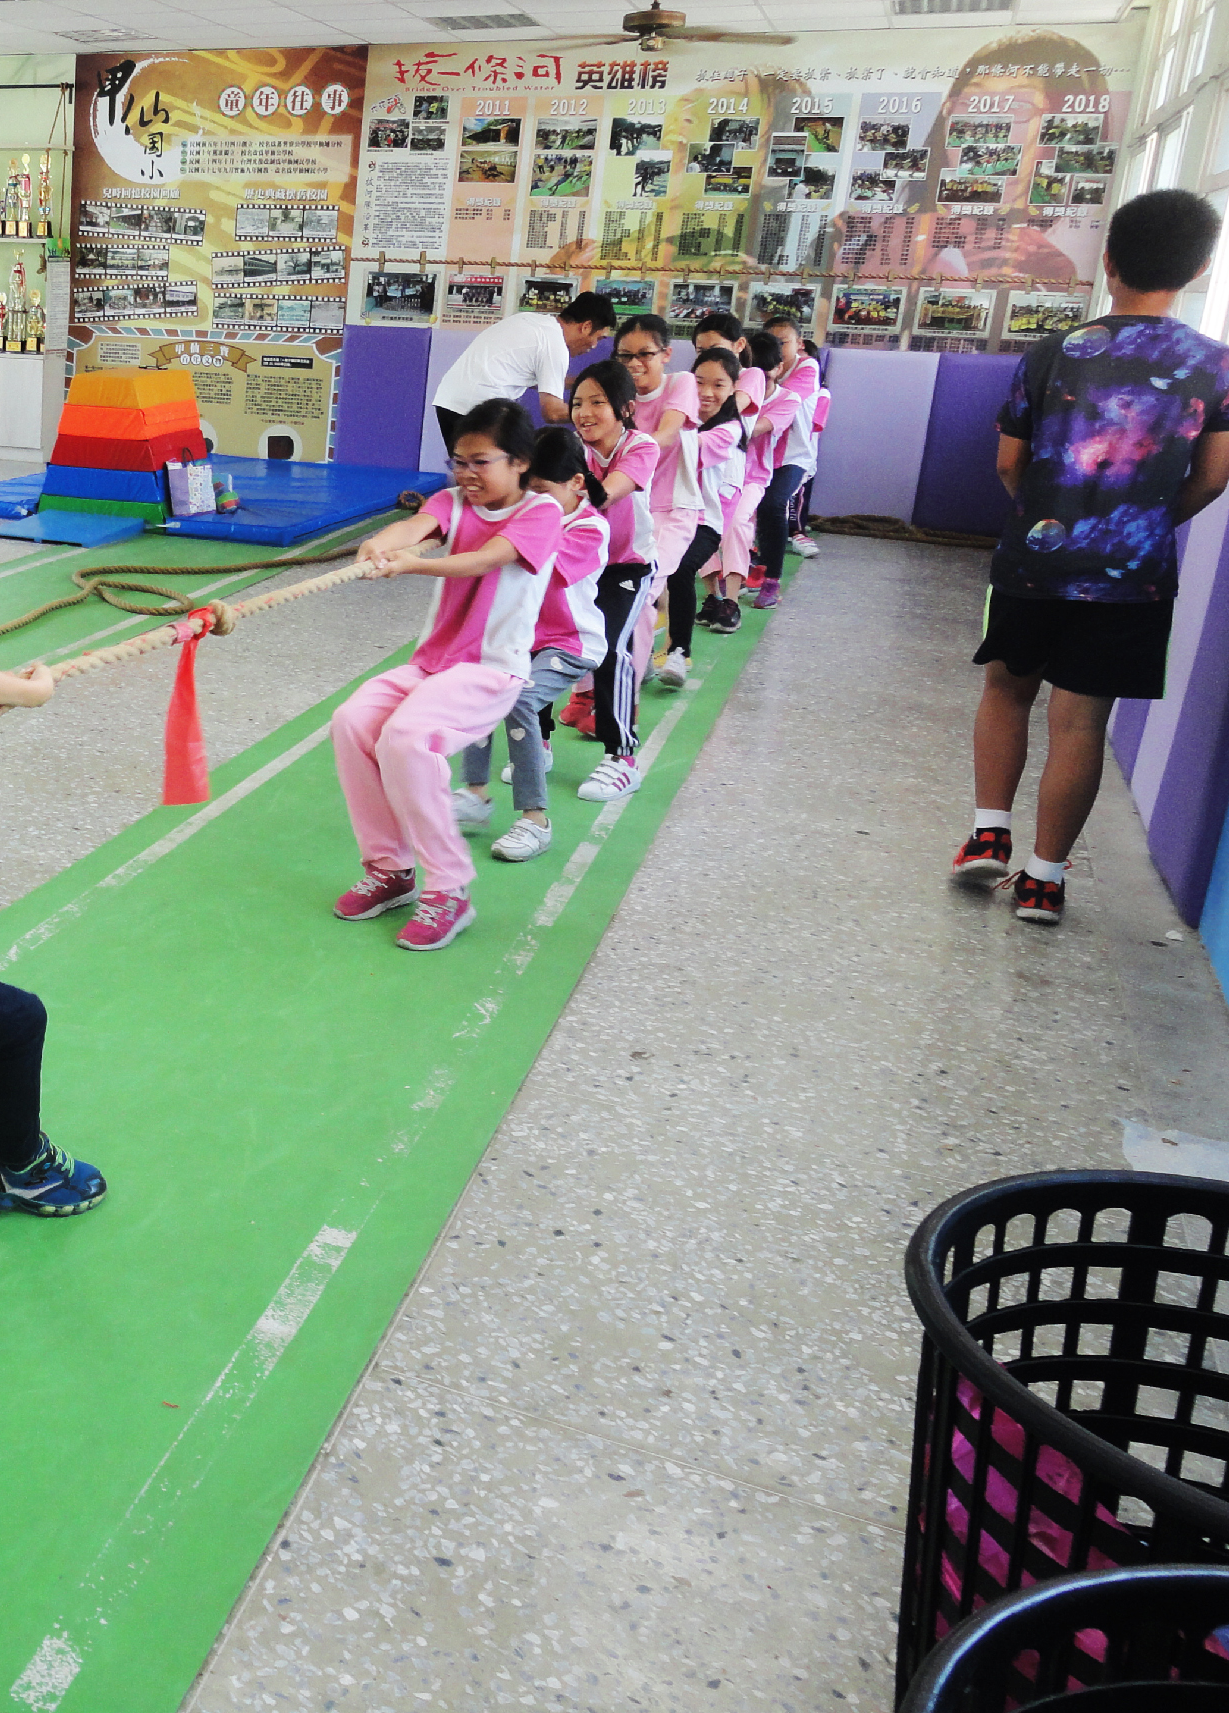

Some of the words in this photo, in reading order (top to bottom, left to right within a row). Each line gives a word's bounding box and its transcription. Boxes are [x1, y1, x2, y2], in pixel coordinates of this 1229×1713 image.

[393, 51, 563, 86] 拔一條河
[575, 59, 669, 92] 英雄榜
[223, 88, 346, 113] 童年往事
[475, 99, 511, 116] 2011
[550, 98, 588, 116] 2012
[628, 98, 667, 115] 2013
[707, 97, 749, 115] 2014
[790, 97, 834, 114] 2015
[877, 96, 922, 113] 2016
[967, 95, 1015, 113] 2017
[1061, 94, 1110, 113] 2018
